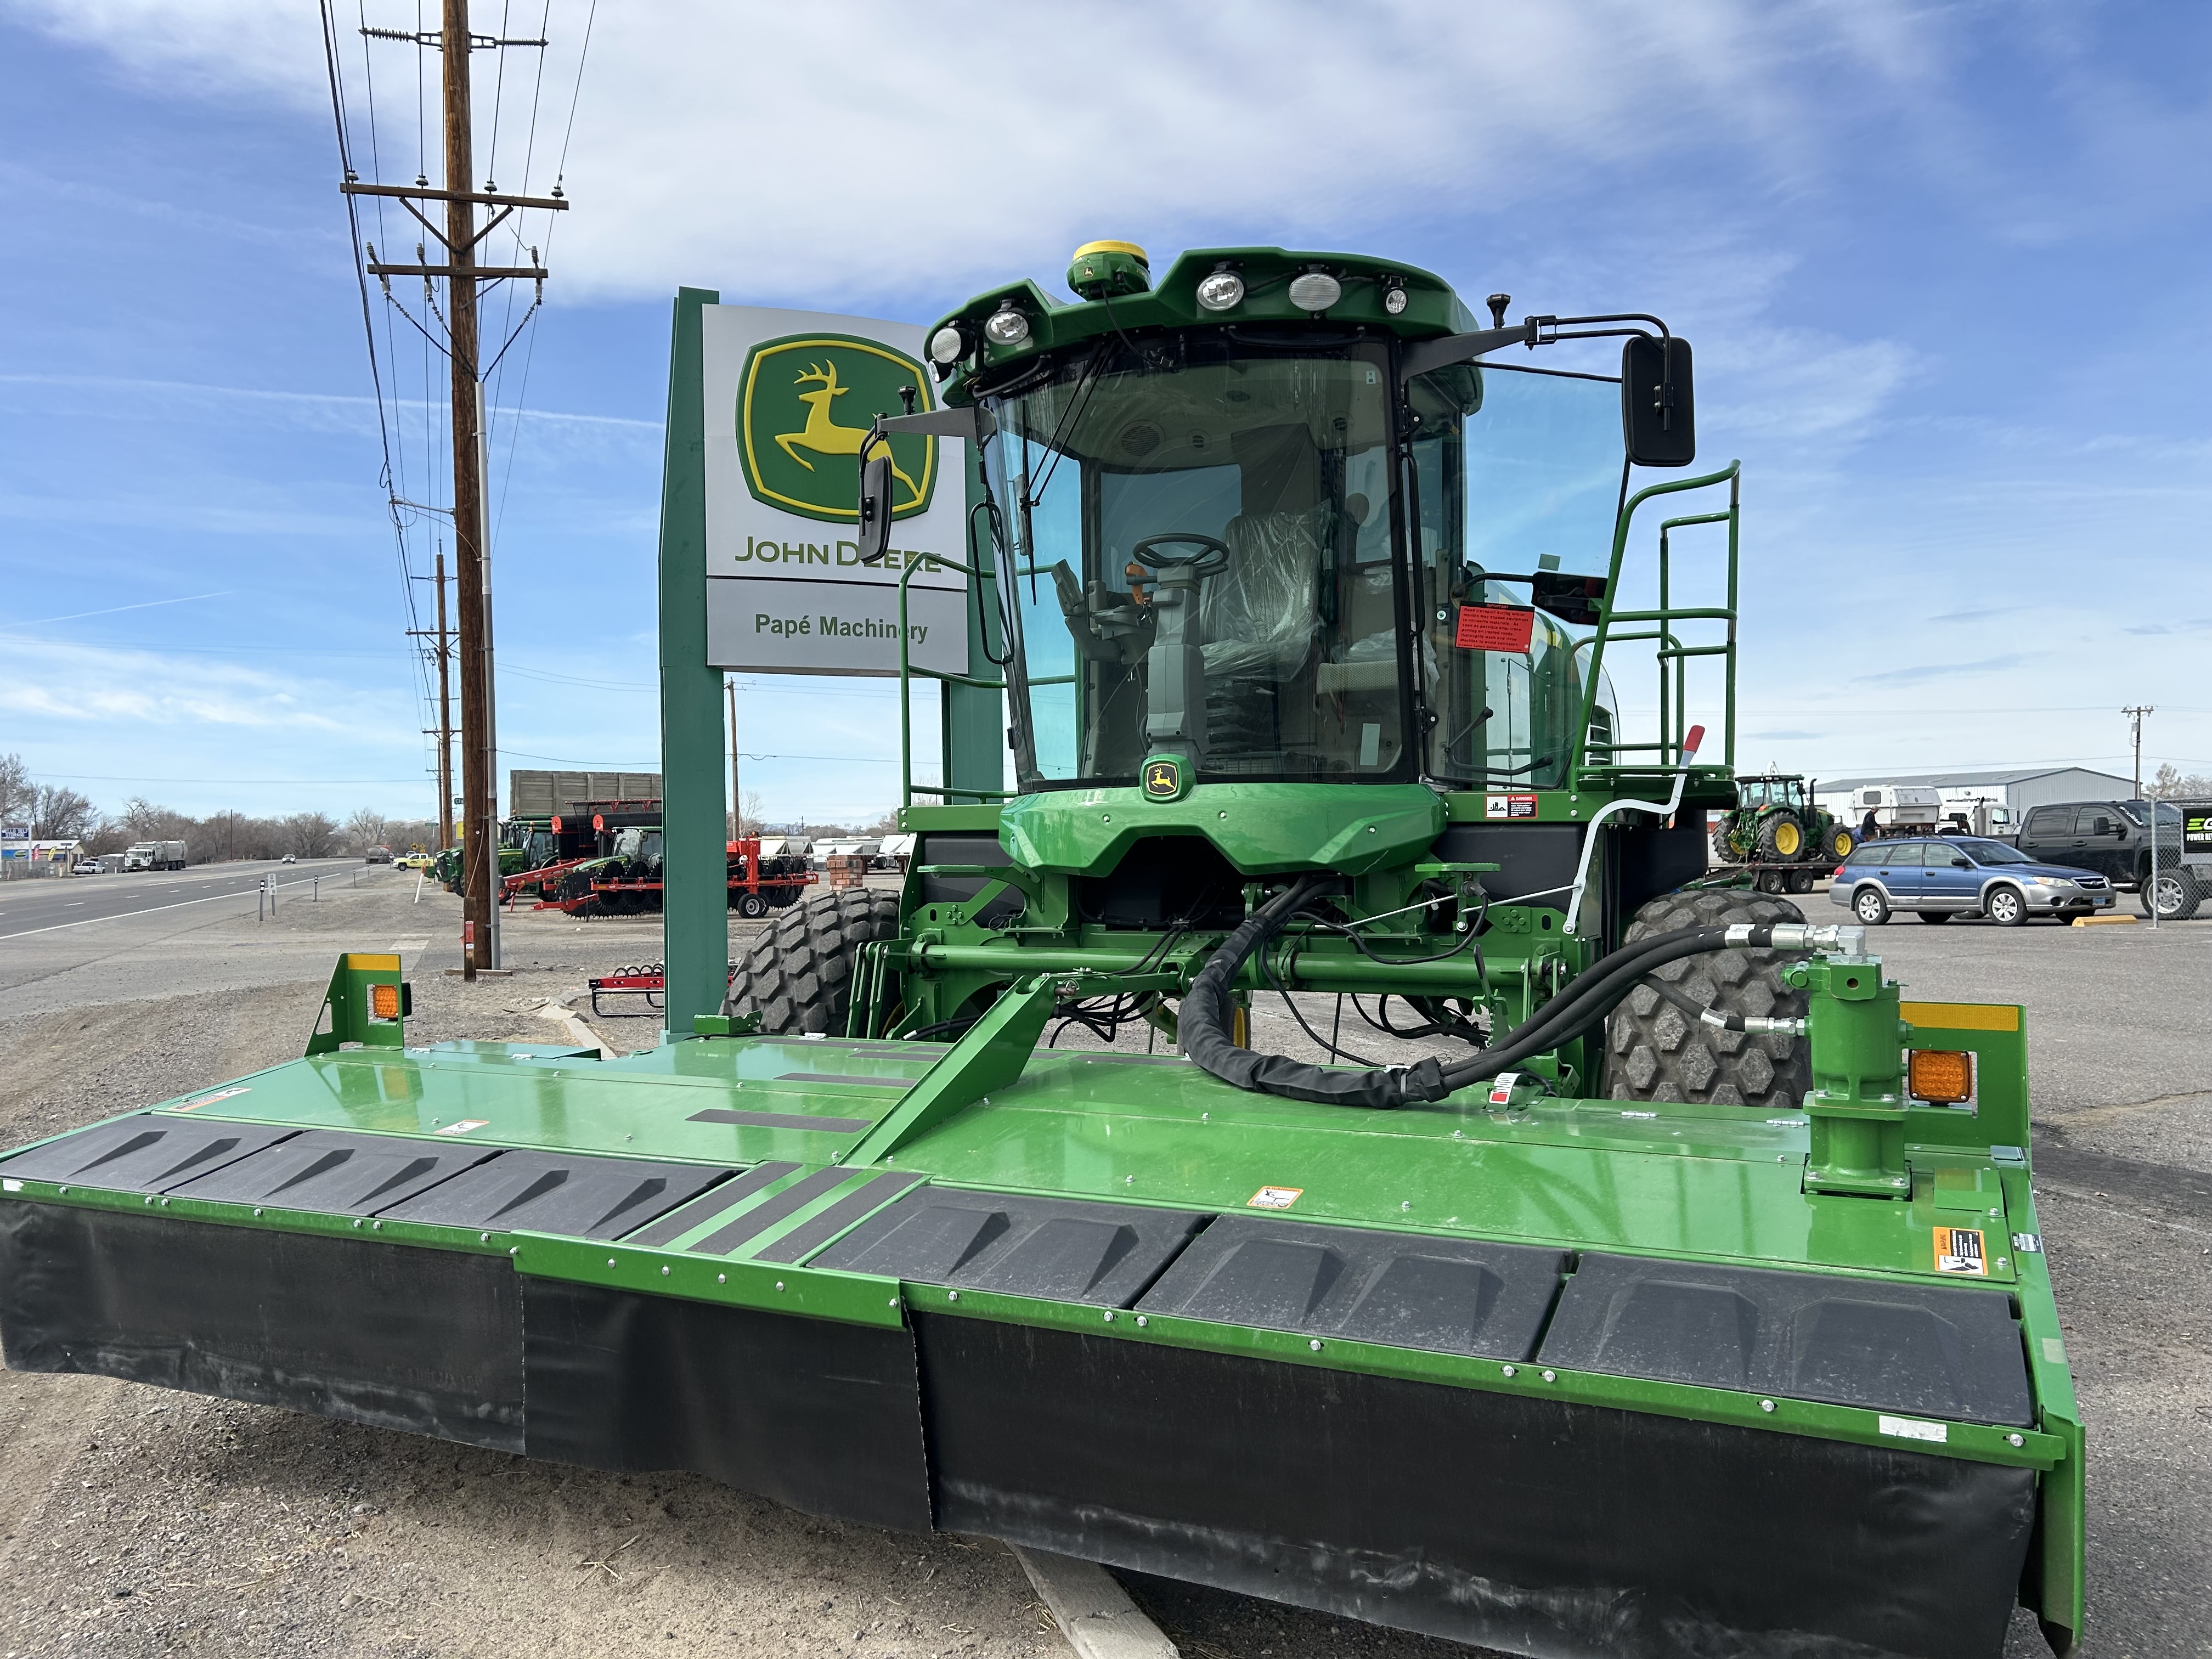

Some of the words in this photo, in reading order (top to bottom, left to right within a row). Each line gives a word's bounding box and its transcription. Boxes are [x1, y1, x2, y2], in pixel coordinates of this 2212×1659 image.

[735, 537, 829, 565] JOHN
[837, 540, 941, 573] DERE
[755, 614, 811, 639] Papé
[2186, 833, 2204, 841] POWER
